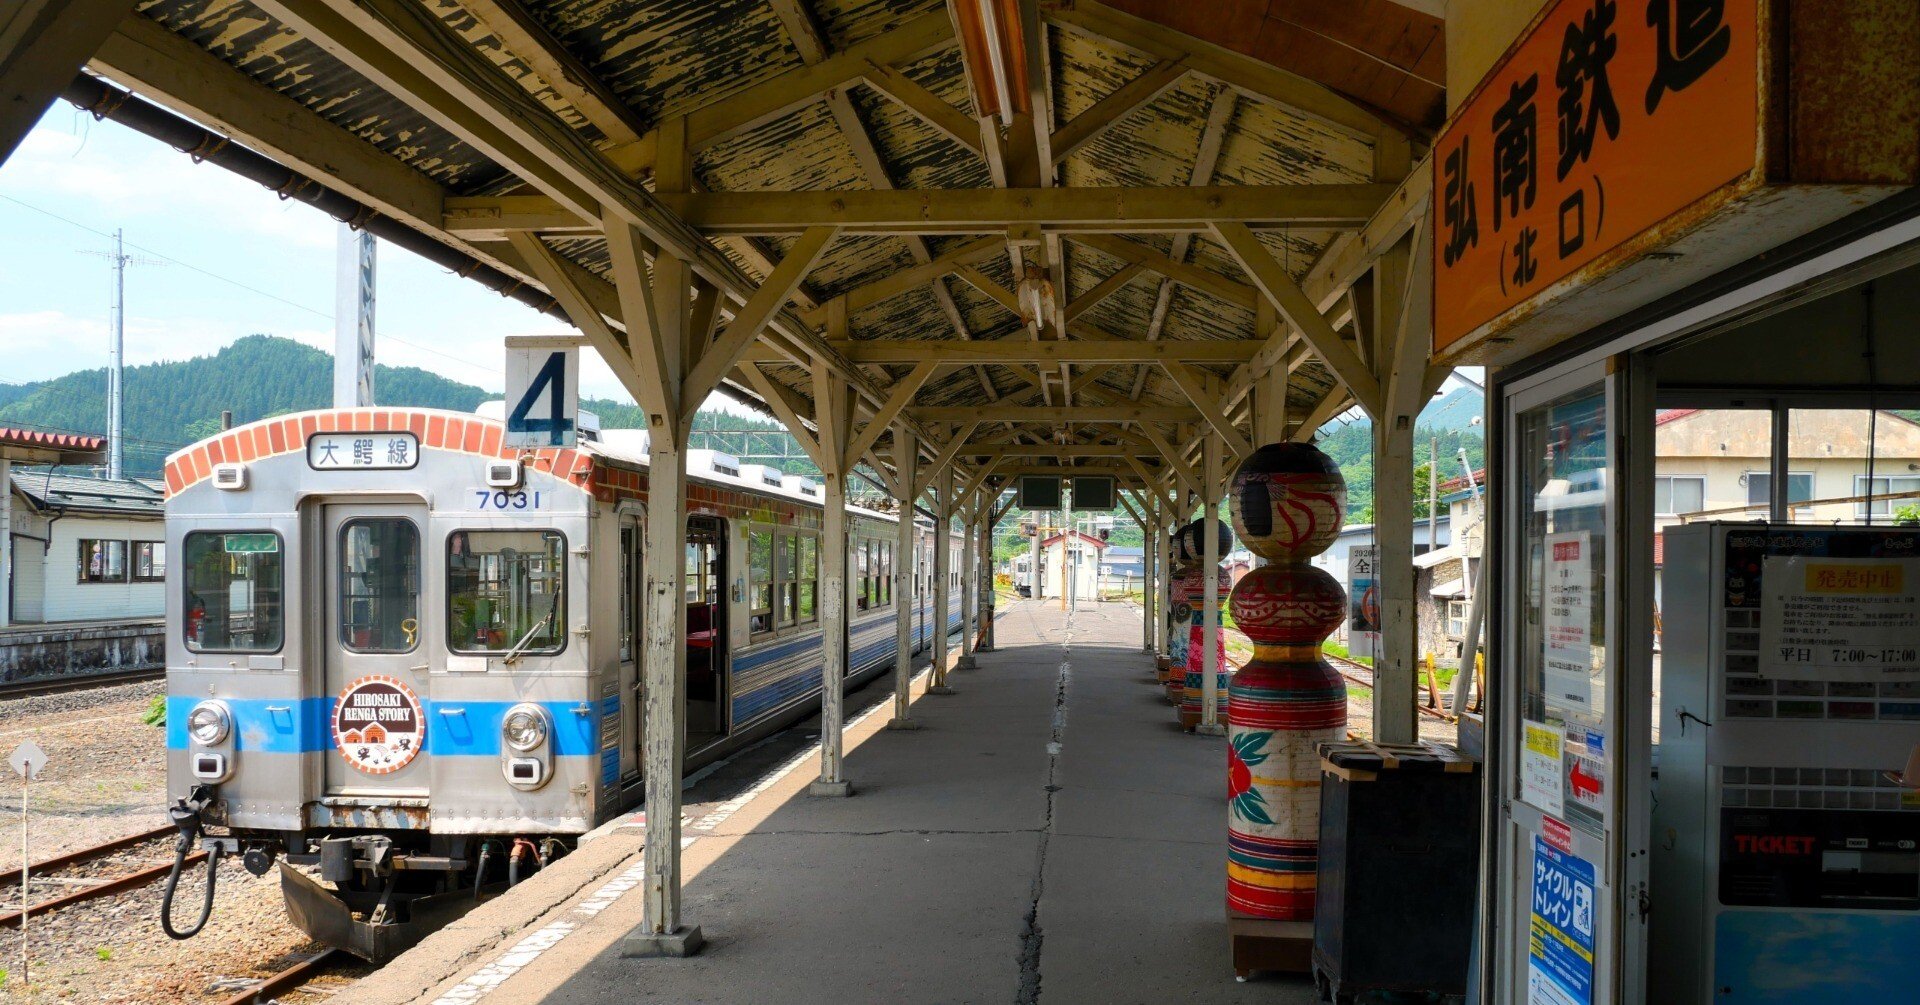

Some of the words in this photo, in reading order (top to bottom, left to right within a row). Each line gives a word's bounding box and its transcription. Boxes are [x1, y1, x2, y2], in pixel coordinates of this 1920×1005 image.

[1444, 0, 1731, 268] 弘南鉄道
[508, 352, 574, 445] 4
[319, 438, 409, 466] 大鰐線
[475, 490, 540, 510] 7031
[1815, 568, 1895, 589] 発売中止
[1779, 647, 1811, 662] 平日
[353, 693, 402, 708] HIROSAKI
[343, 706, 376, 722] RENGA
[378, 706, 410, 722] STORY
[1733, 834, 1815, 855] TICKET
[1536, 859, 1572, 901] サイクル
[1535, 885, 1571, 928] トレイン
